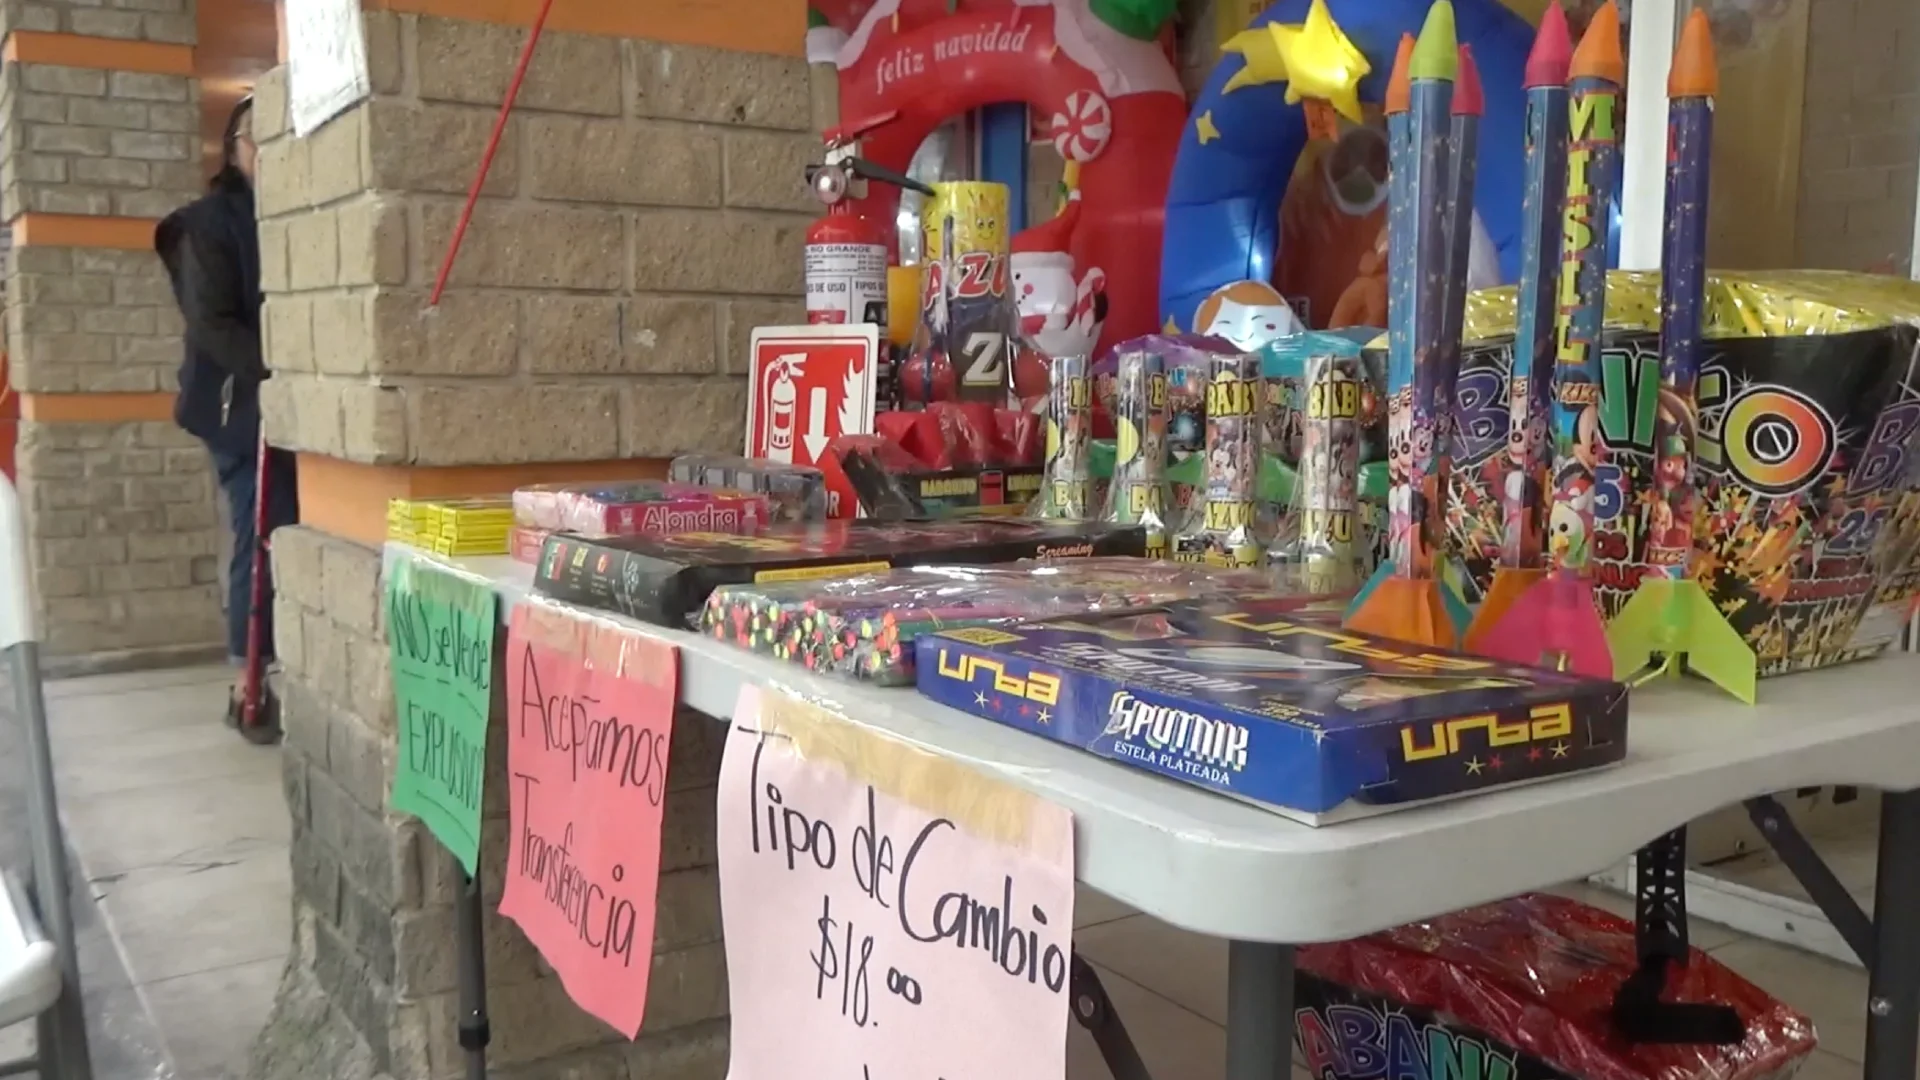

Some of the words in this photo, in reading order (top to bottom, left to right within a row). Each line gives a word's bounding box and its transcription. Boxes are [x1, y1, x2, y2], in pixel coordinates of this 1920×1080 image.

[876, 47, 925, 94] feliz
[934, 24, 1032, 61] navidad
[827, 283, 846, 292] USO
[1308, 379, 1360, 418] BAB
[641, 504, 738, 534] Alondra
[1036, 543, 1094, 559] Screaming
[391, 587, 431, 664] NO
[1113, 740, 1157, 765] ESTELA
[1158, 752, 1232, 786] PLATEADA
[737, 725, 837, 870] Tipo
[852, 785, 894, 908] de
[899, 818, 1066, 993] Cambio
